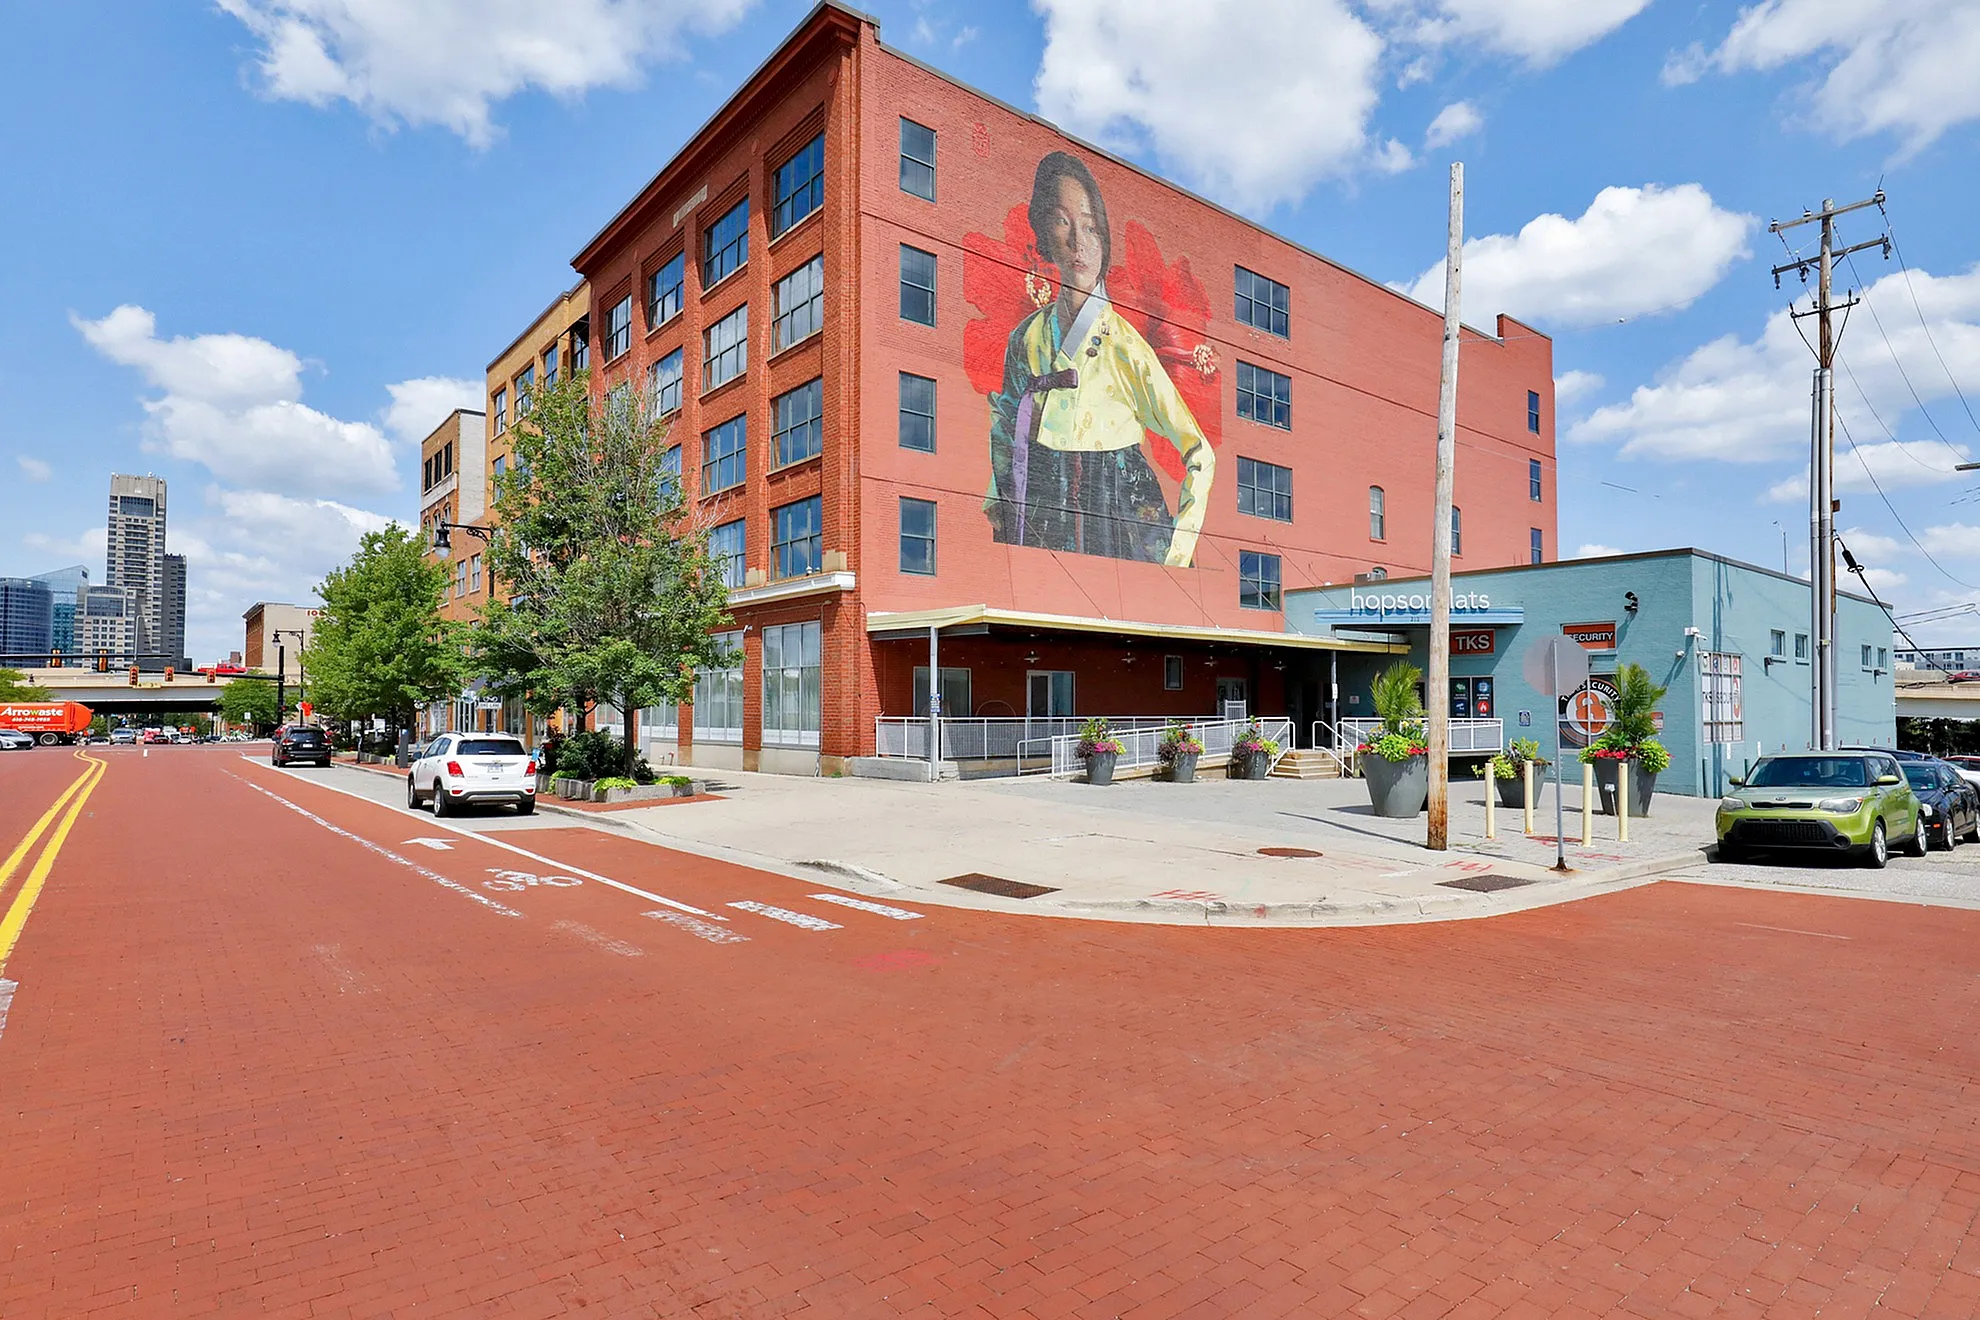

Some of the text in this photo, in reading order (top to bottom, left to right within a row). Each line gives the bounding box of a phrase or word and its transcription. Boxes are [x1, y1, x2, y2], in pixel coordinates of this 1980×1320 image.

[1450, 587, 1490, 609] lats
[1455, 634, 1490, 650] TKS
[1582, 680, 1621, 702] SCURITY
[0, 706, 64, 717] Arrowaste
